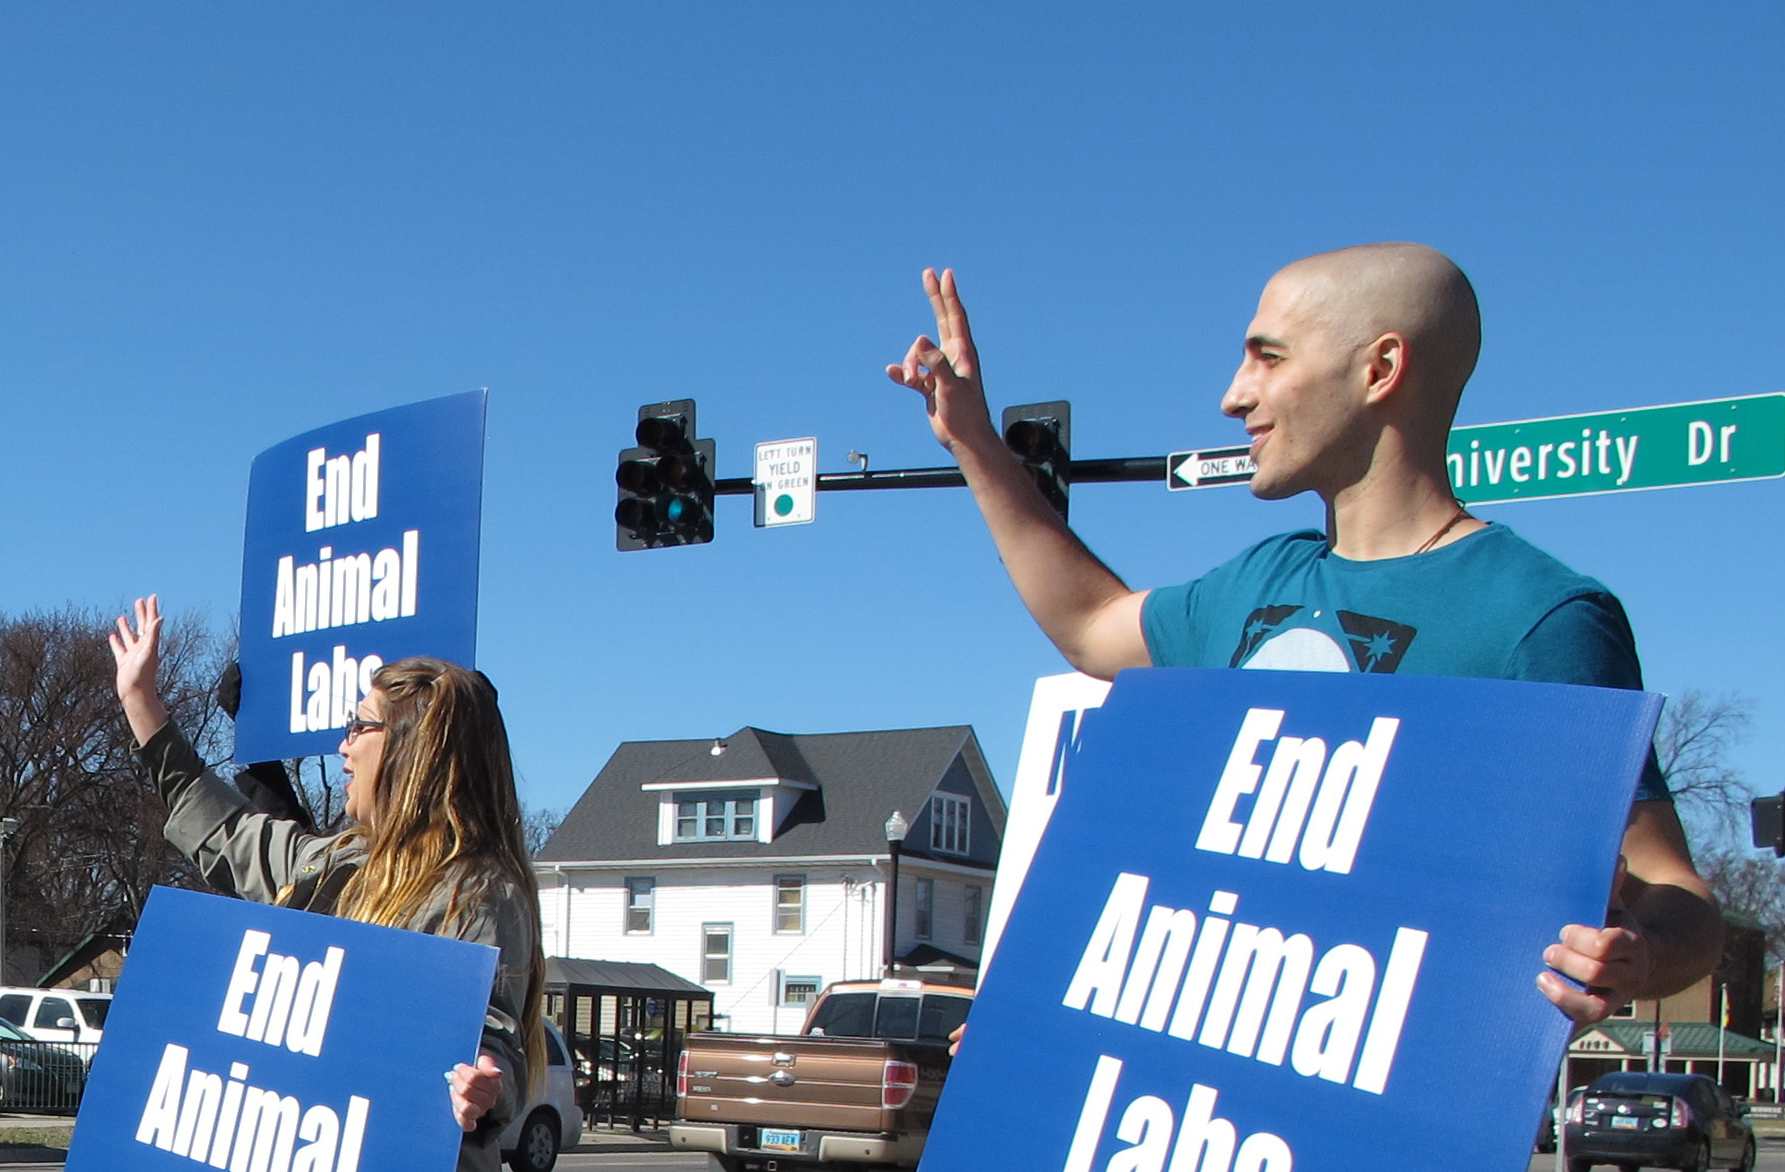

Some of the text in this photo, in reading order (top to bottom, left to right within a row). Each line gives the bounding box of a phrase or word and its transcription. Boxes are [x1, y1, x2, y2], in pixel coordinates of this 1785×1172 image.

[305, 432, 380, 533] End
[758, 446, 811, 461] LEFT TURN
[760, 477, 809, 491] ON GREEN
[769, 461, 801, 476] YIELD
[1200, 457, 1257, 476] ONE WA
[1446, 420, 1738, 486] niversity Dr
[272, 529, 419, 639] Animal
[1196, 707, 1400, 875] End
[217, 929, 345, 1057] End
[1062, 871, 1428, 1095] Animal
